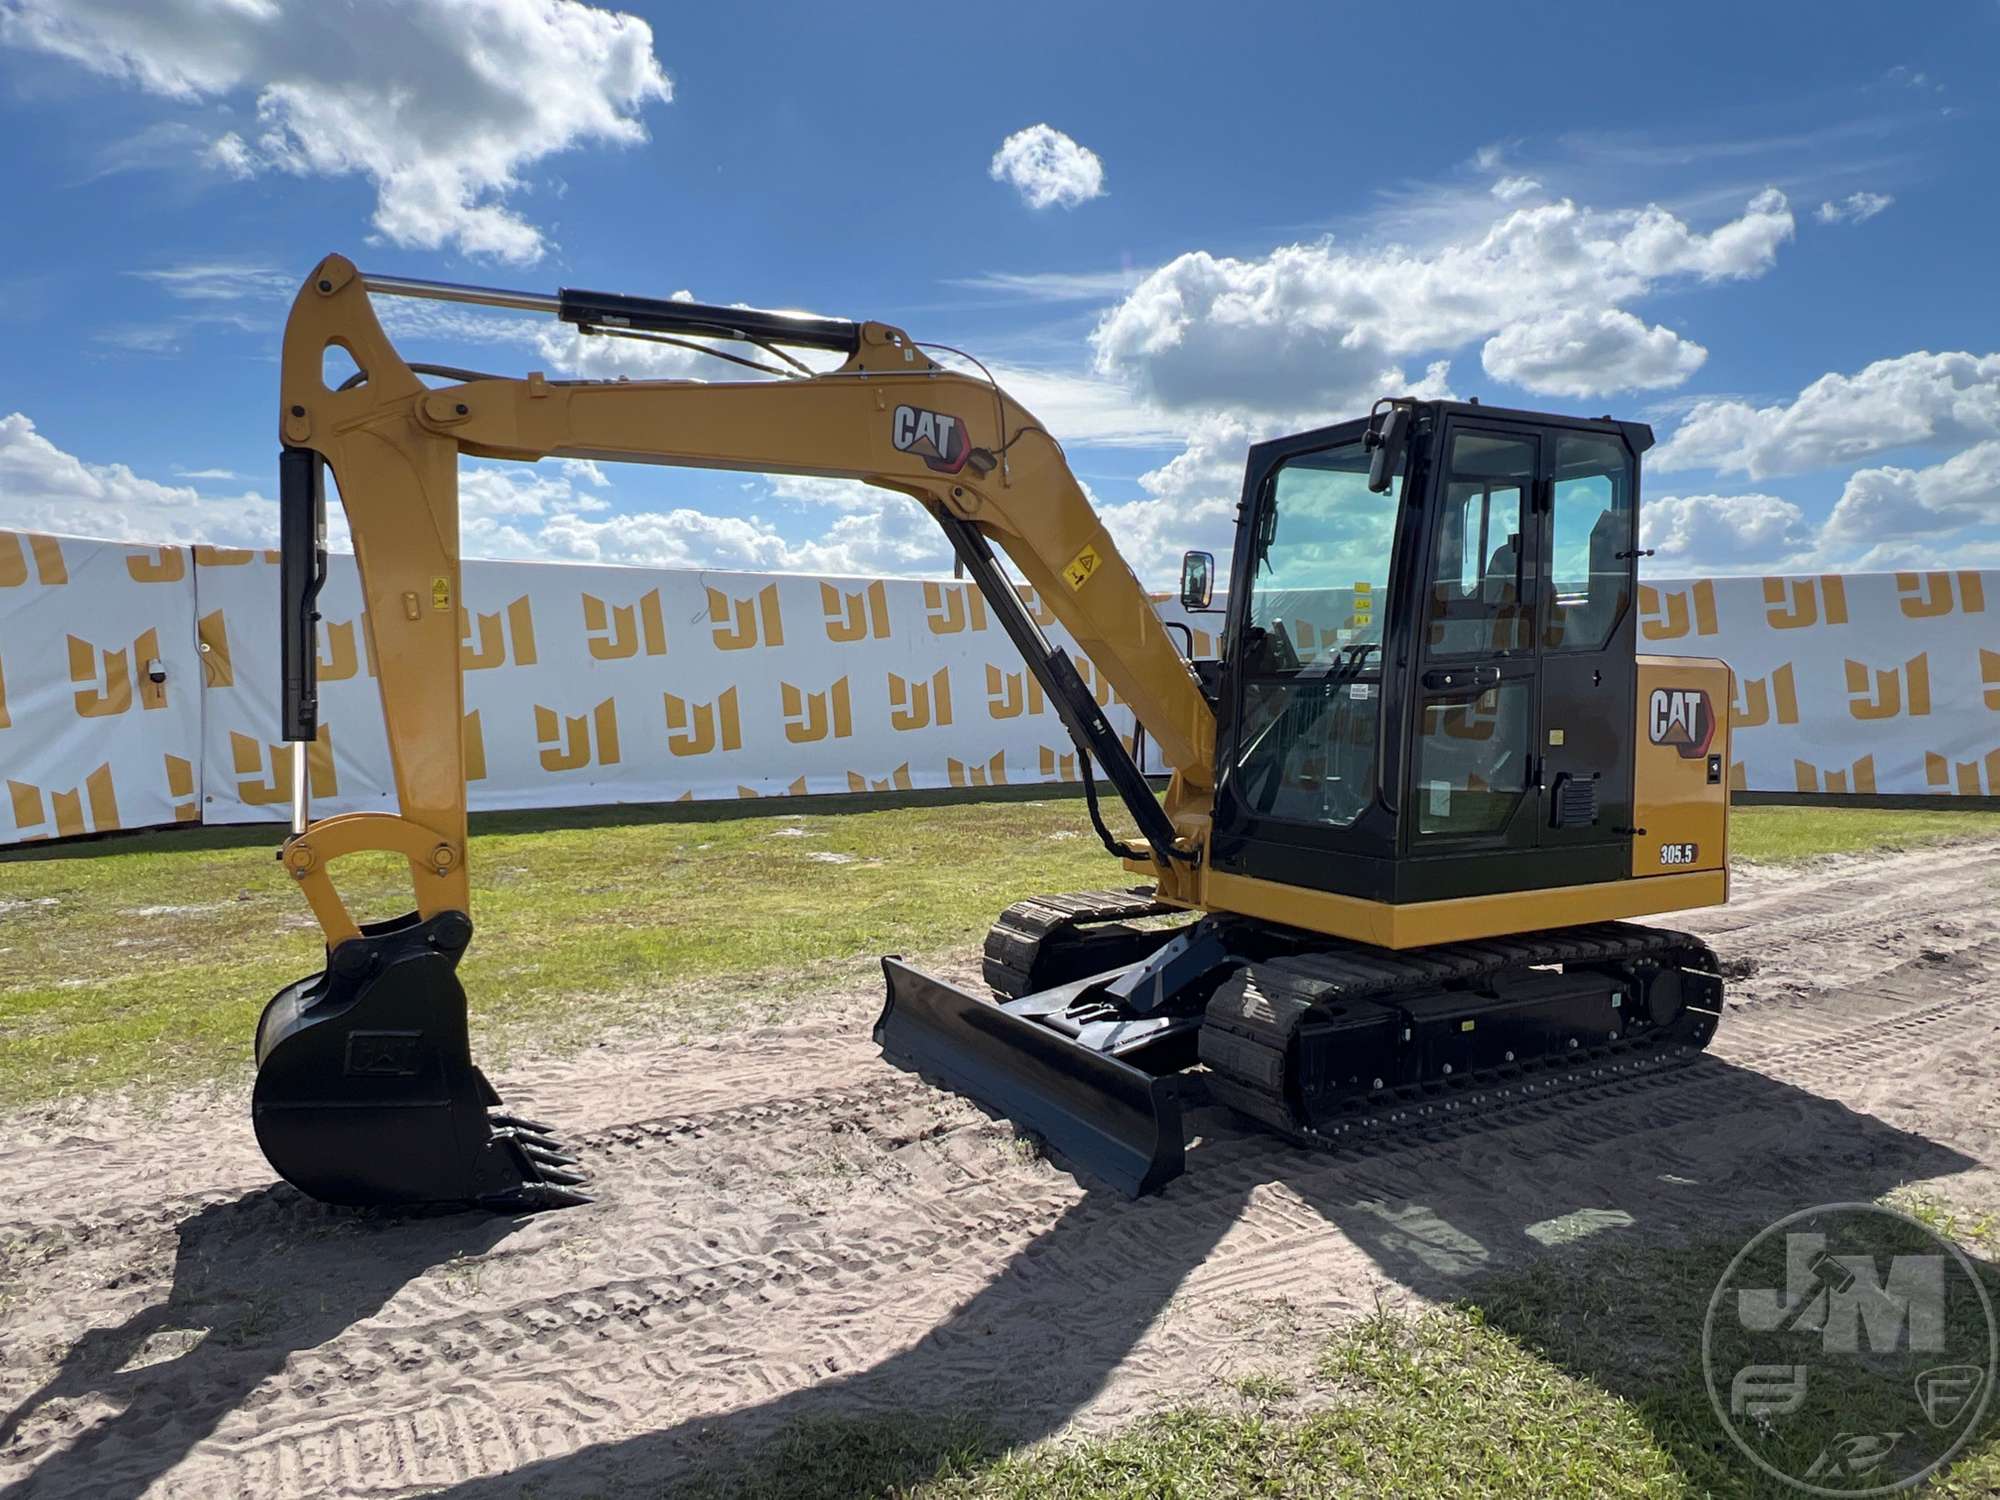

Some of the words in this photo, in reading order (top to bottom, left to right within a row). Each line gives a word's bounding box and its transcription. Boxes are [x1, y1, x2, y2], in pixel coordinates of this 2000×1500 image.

[894, 405, 955, 460] CAT
[1650, 690, 1701, 743] CAT
[1660, 844, 1693, 864] 305.5
